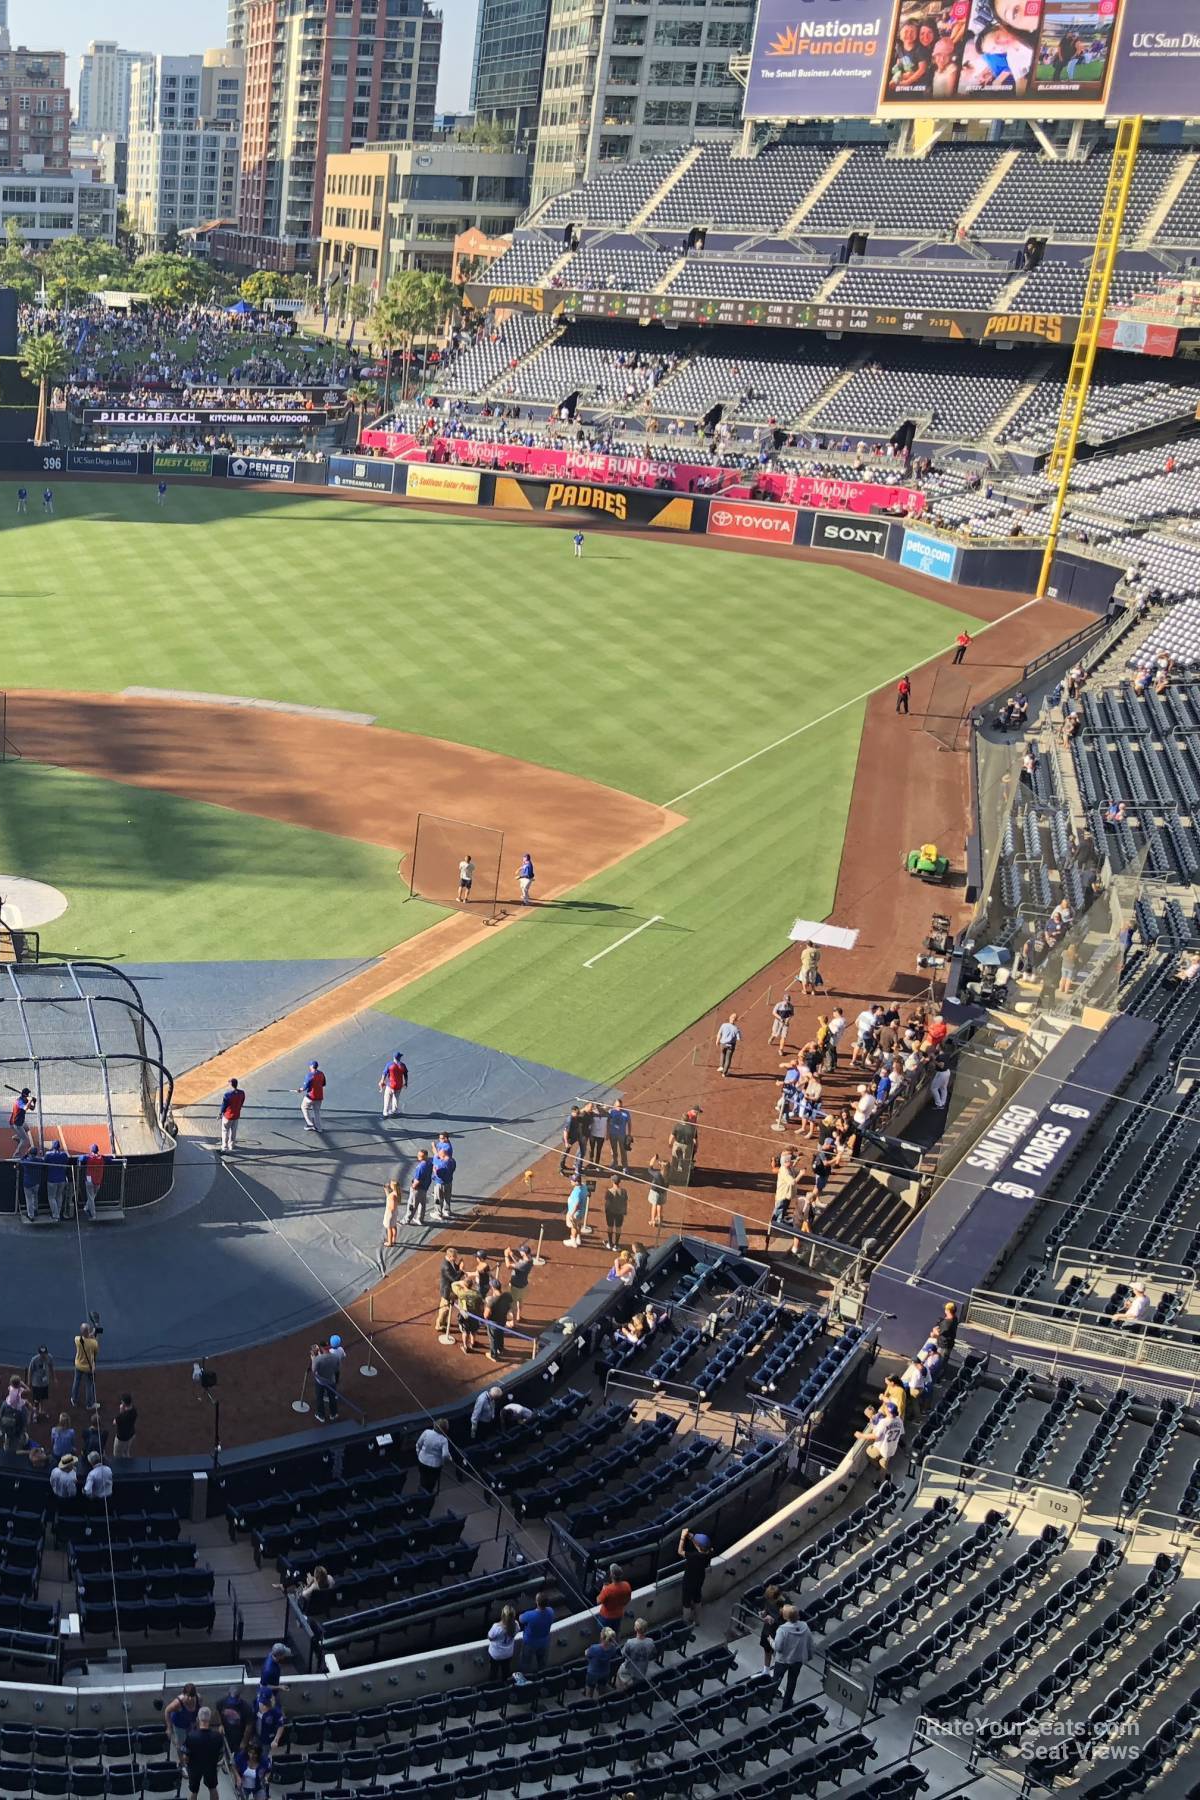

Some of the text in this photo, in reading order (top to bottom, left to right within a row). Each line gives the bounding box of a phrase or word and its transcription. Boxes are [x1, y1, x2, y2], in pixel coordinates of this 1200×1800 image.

[800, 18, 881, 38] National
[1132, 33, 1154, 48] UC
[1154, 33, 1180, 48] San
[798, 38, 877, 57] Funding
[761, 68, 872, 78] The Small Business Advantage
[488, 287, 544, 312] PADRES
[720, 302, 734, 311] ARI
[768, 305, 782, 314] CIN
[787, 306, 793, 314] 2
[689, 311, 695, 319] 4
[718, 313, 733, 321] ATL
[819, 308, 834, 317] SEA
[851, 309, 869, 318] LAA
[904, 312, 924, 321] OAK
[767, 316, 791, 325] STL 1
[817, 319, 832, 327] COL
[850, 320, 867, 328] LAD
[875, 316, 897, 324] 7:10
[929, 318, 951, 327] 7:15
[902, 322, 915, 331] SF
[984, 315, 1062, 343] PADRES
[155, 412, 196, 423] BEACH
[209, 414, 310, 424] KITCHEN. BATH. OUTDOOR.
[43, 457, 61, 470] 396
[156, 457, 209, 468] WEST LAKE
[249, 462, 290, 473] PENFED
[566, 453, 677, 479] HOME RUN DECK
[341, 479, 373, 488] STREAMING
[442, 479, 458, 489] Solar
[459, 481, 477, 492] Power
[812, 480, 858, 499] Mobile
[545, 483, 627, 521] PADRES
[734, 514, 791, 532] TOYOTA
[824, 525, 883, 545] SONY
[906, 539, 950, 563] petco.com
[966, 1104, 1038, 1171] SAN DIEGO
[1012, 1123, 1071, 1177] PADRES
[887, 1430, 900, 1442] 27
[1049, 1500, 1069, 1514] 103
[838, 1684, 853, 1702] 101
